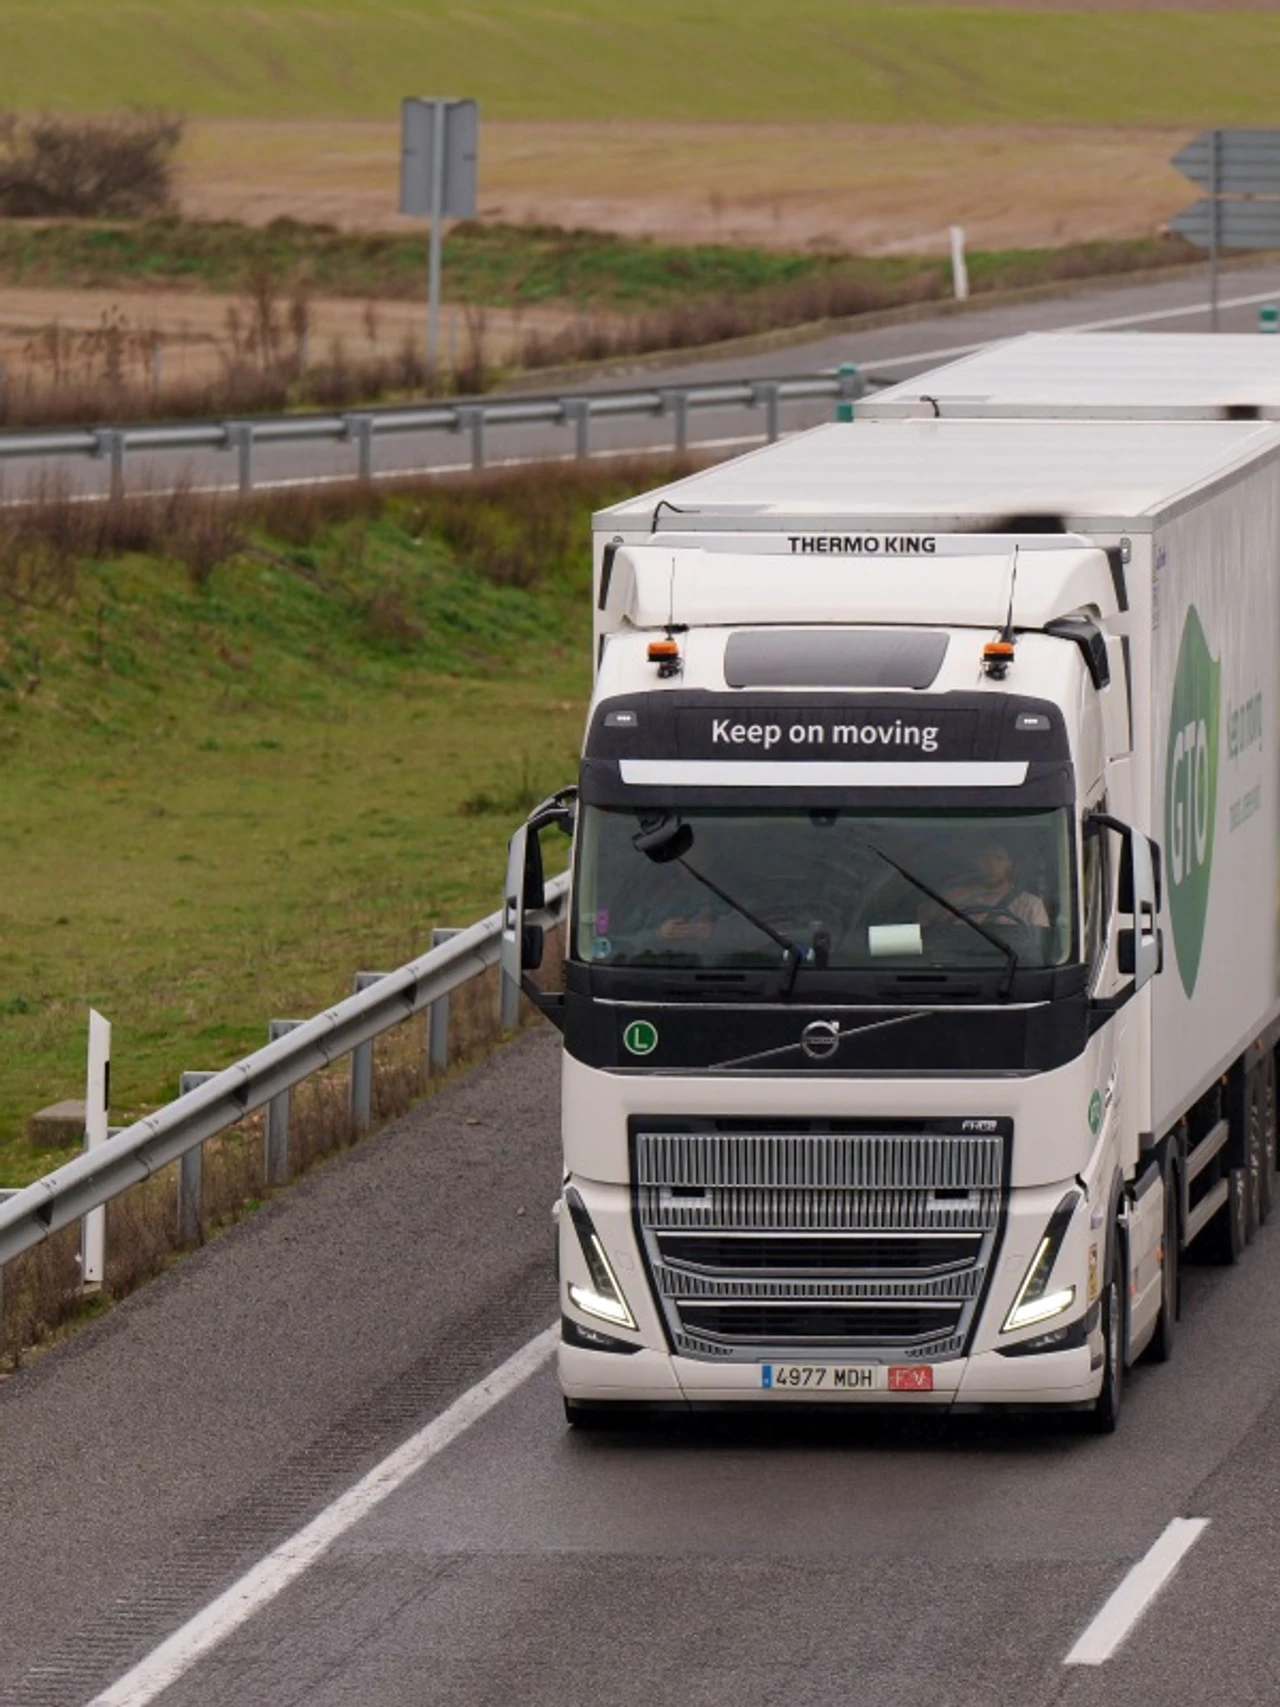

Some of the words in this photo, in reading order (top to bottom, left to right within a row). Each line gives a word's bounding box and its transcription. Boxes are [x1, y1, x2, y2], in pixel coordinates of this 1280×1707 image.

[787, 536, 880, 553] THERMO
[885, 536, 936, 553] KING
[712, 719, 782, 749] Keep
[789, 724, 824, 743] on
[832, 719, 939, 752] moving
[1171, 718, 1209, 886] GTO
[634, 1027, 648, 1048] L
[776, 1367, 826, 1386] 4977
[834, 1369, 872, 1387] MDH
